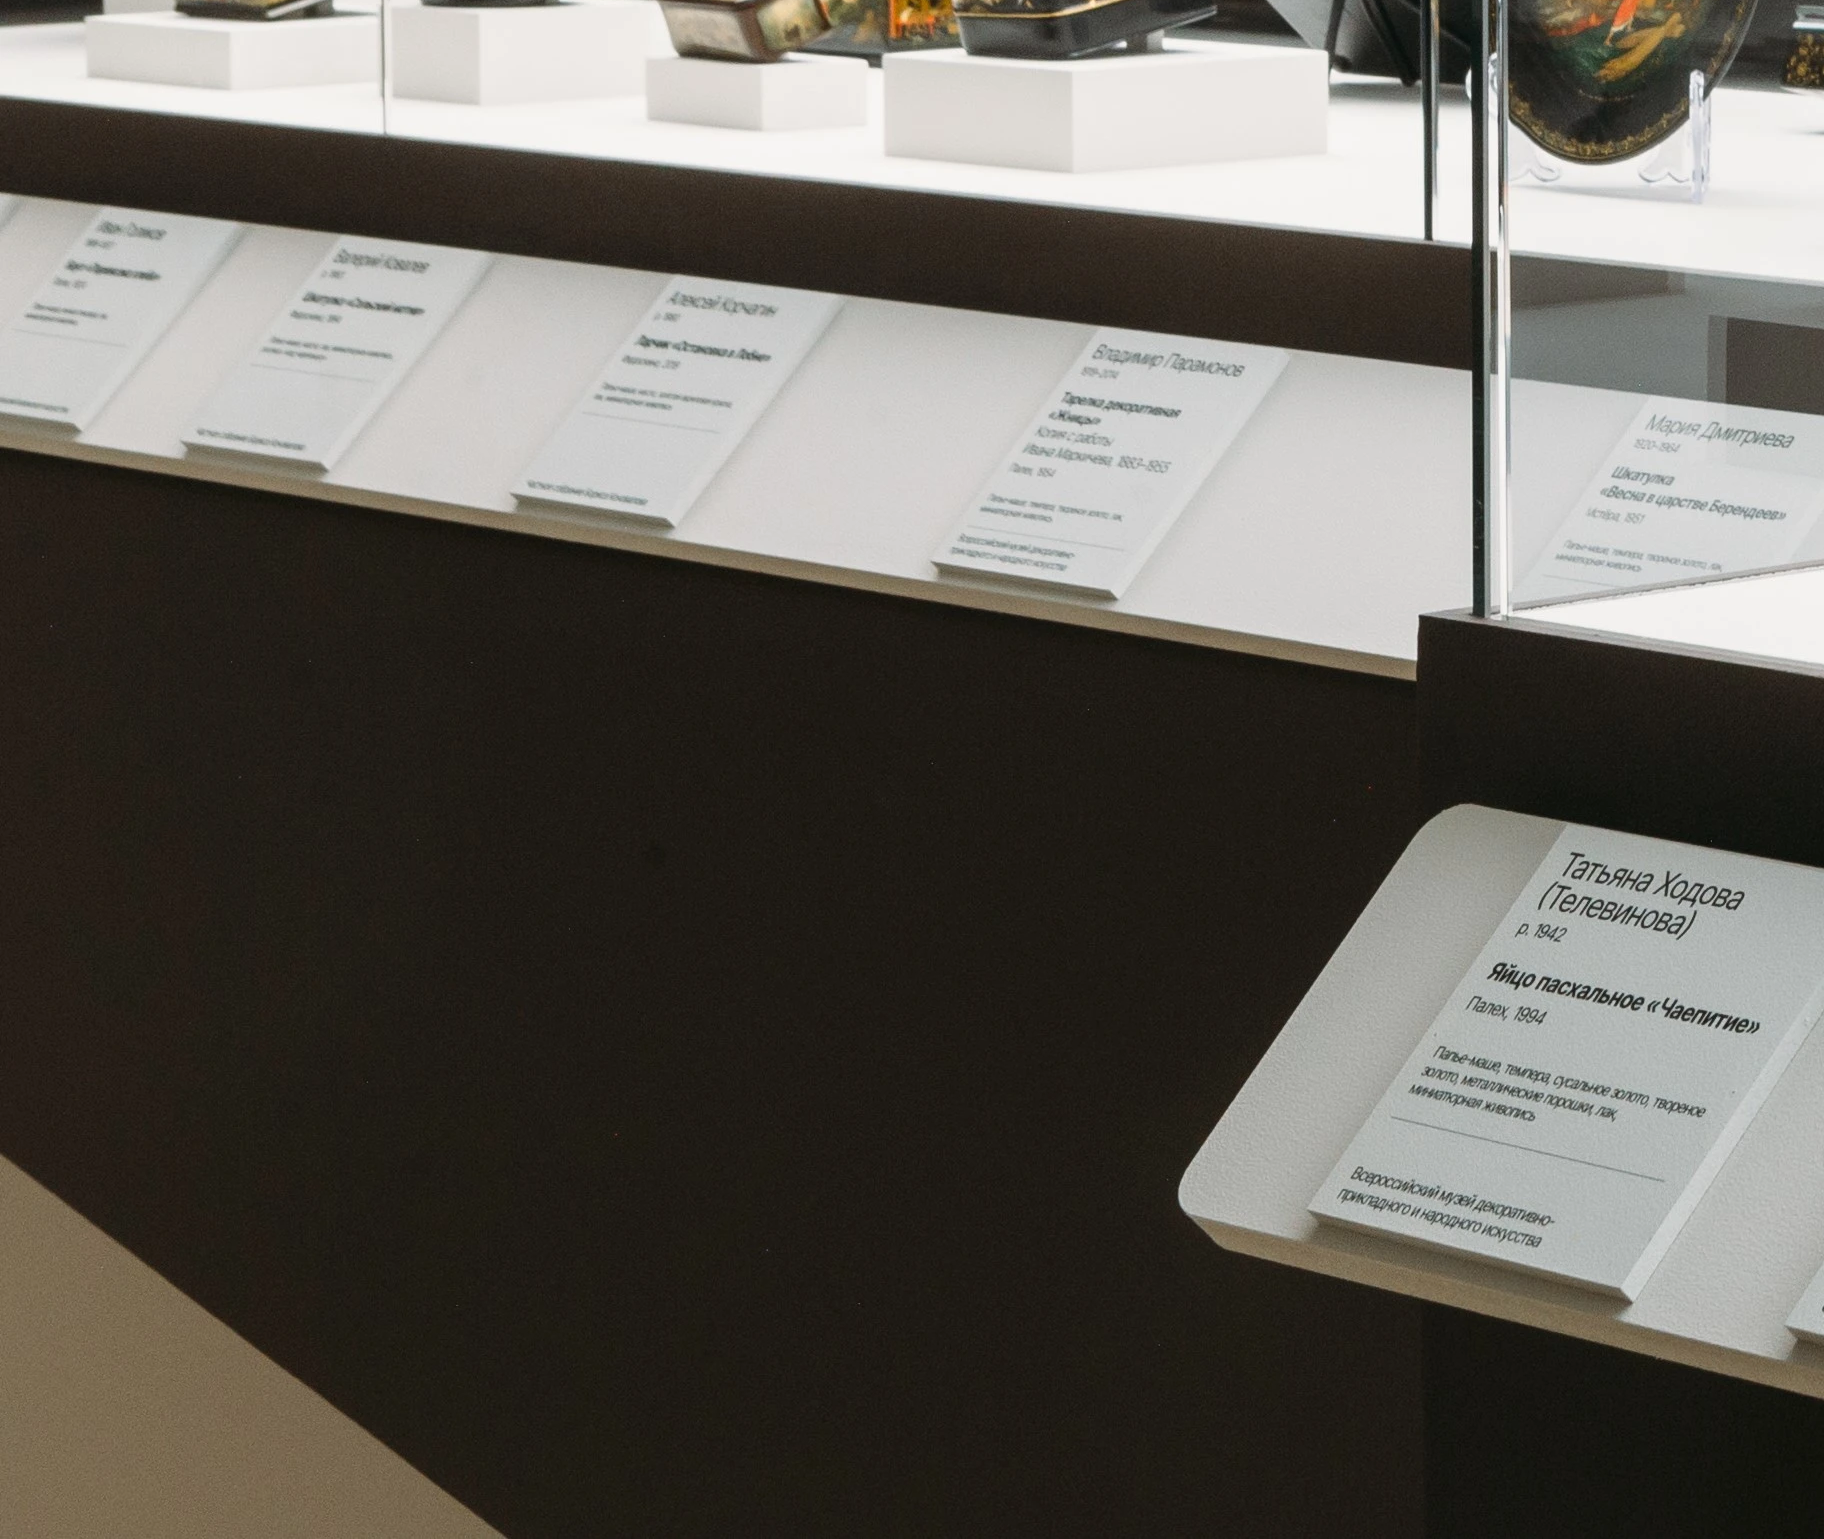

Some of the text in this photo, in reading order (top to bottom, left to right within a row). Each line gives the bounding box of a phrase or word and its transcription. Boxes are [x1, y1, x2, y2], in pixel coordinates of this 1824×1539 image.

[1646, 414, 1795, 448] Мария Дмитриева
[1600, 485, 1786, 520] «Весна в царстве Берендеев»
[1611, 466, 1675, 486] Шкатулка
[1561, 851, 1746, 911] Татьяна Ходова
[1514, 922, 1568, 943] р. 1942
[1537, 881, 1698, 941] (Телевинова)
[1465, 995, 1548, 1026] Палех, 1994
[1486, 962, 1761, 1035] Яйцо пасхальное «Чаепитие»
[1408, 1084, 1537, 1122] миниатюрная живопись
[1420, 1065, 1618, 1123] золото, металлические порошки, лак,
[1432, 1045, 1707, 1119] Папье-маше, темпера, сусальное золото, твореное
[1336, 1188, 1543, 1248] прикладного и народного искусства
[1349, 1165, 1555, 1227] Всероссийский музей декоративно-
